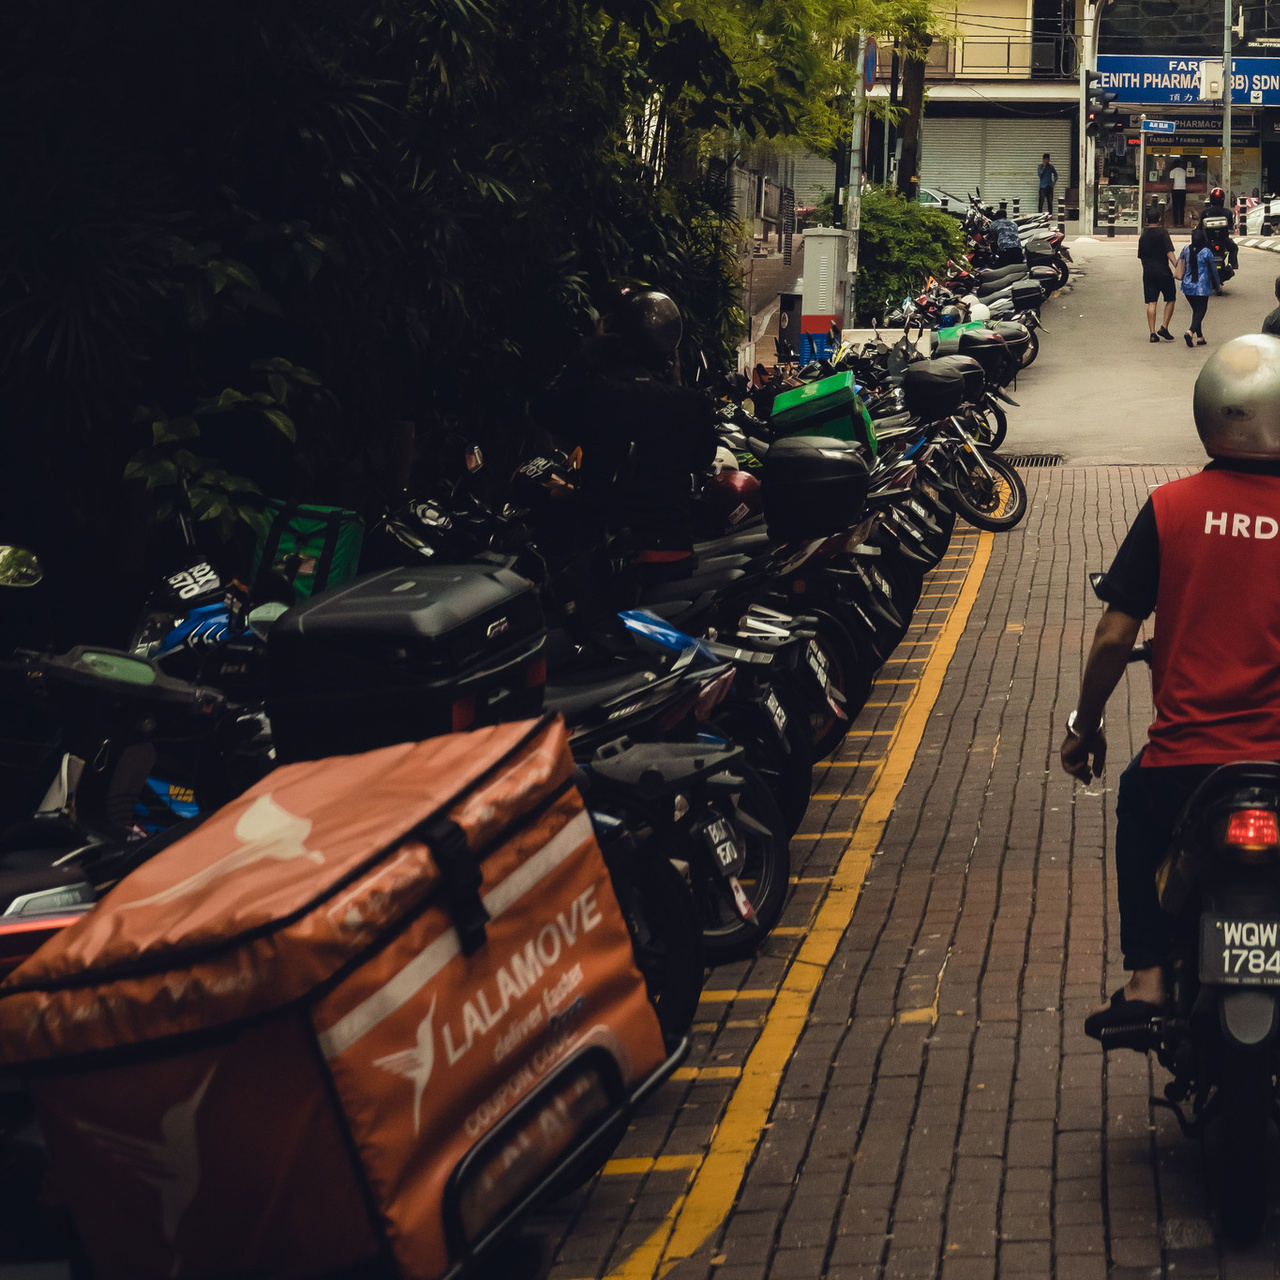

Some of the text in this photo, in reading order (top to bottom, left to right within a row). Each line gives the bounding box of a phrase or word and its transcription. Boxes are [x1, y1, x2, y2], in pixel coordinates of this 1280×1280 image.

[1168, 60, 1236, 72] FARI
[1143, 73, 1201, 90] PHARMA
[1252, 75, 1279, 91] SDN
[1174, 120, 1222, 128] PHARMACY
[1223, 921, 1278, 947] WQW
[441, 884, 604, 1065] LALAMOVE
